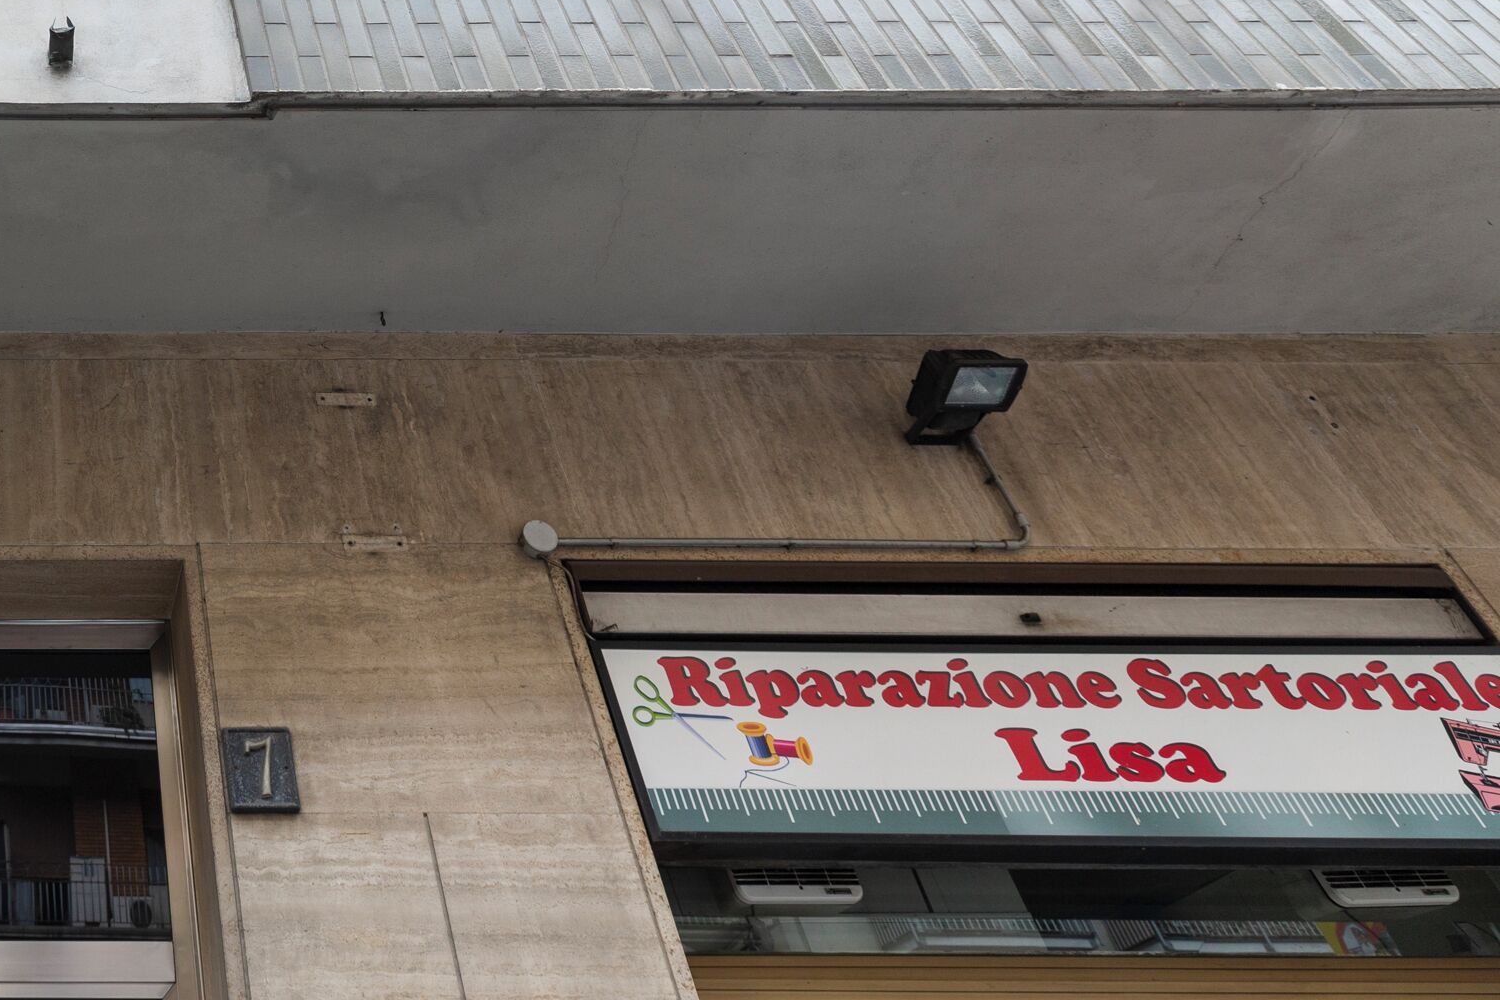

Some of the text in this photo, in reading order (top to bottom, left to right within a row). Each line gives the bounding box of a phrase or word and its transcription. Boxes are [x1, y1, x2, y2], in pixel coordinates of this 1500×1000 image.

[657, 656, 1500, 718] Riparazione Sartoriale
[245, 736, 272, 798] 7
[994, 727, 1227, 784] Lisa
